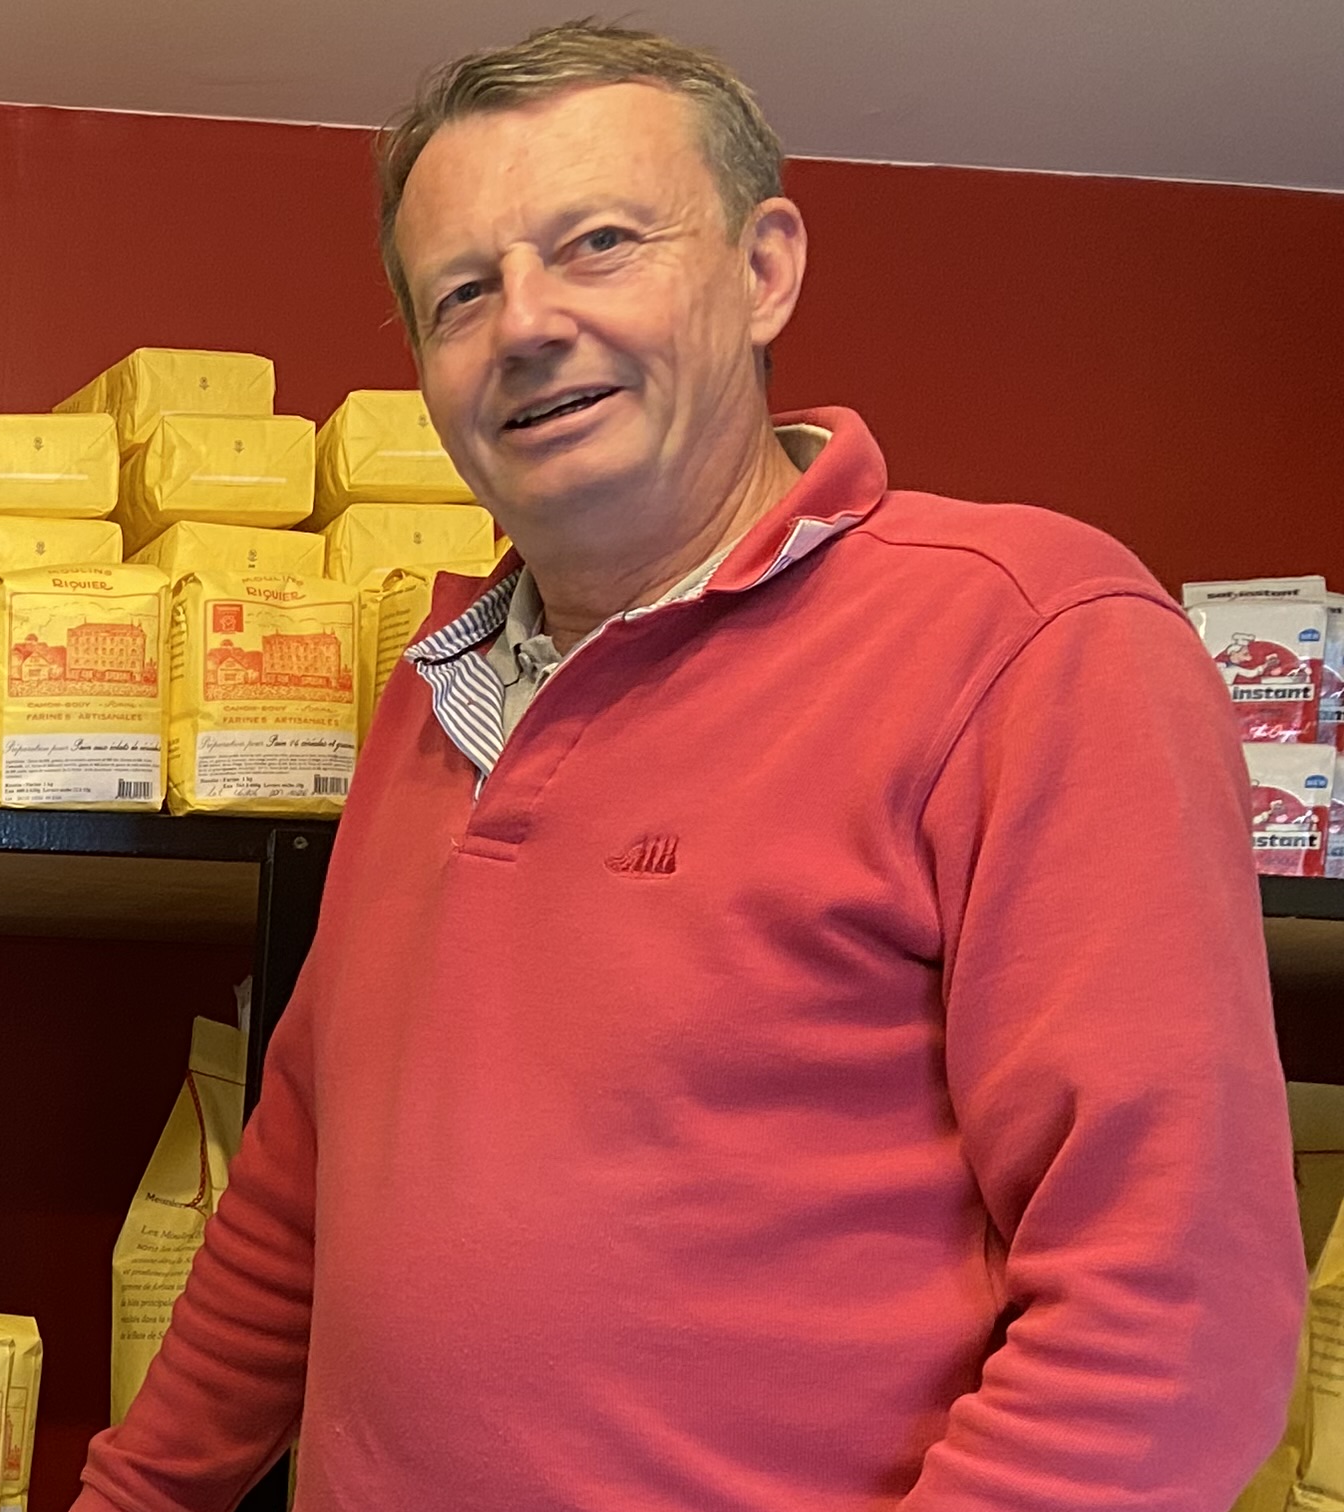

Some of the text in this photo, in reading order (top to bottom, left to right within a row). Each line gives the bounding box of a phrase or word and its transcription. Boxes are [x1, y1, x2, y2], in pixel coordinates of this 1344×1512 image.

[52, 578, 113, 592] RIQUIER
[246, 586, 306, 601] RIQUIER
[1232, 686, 1310, 700] instant
